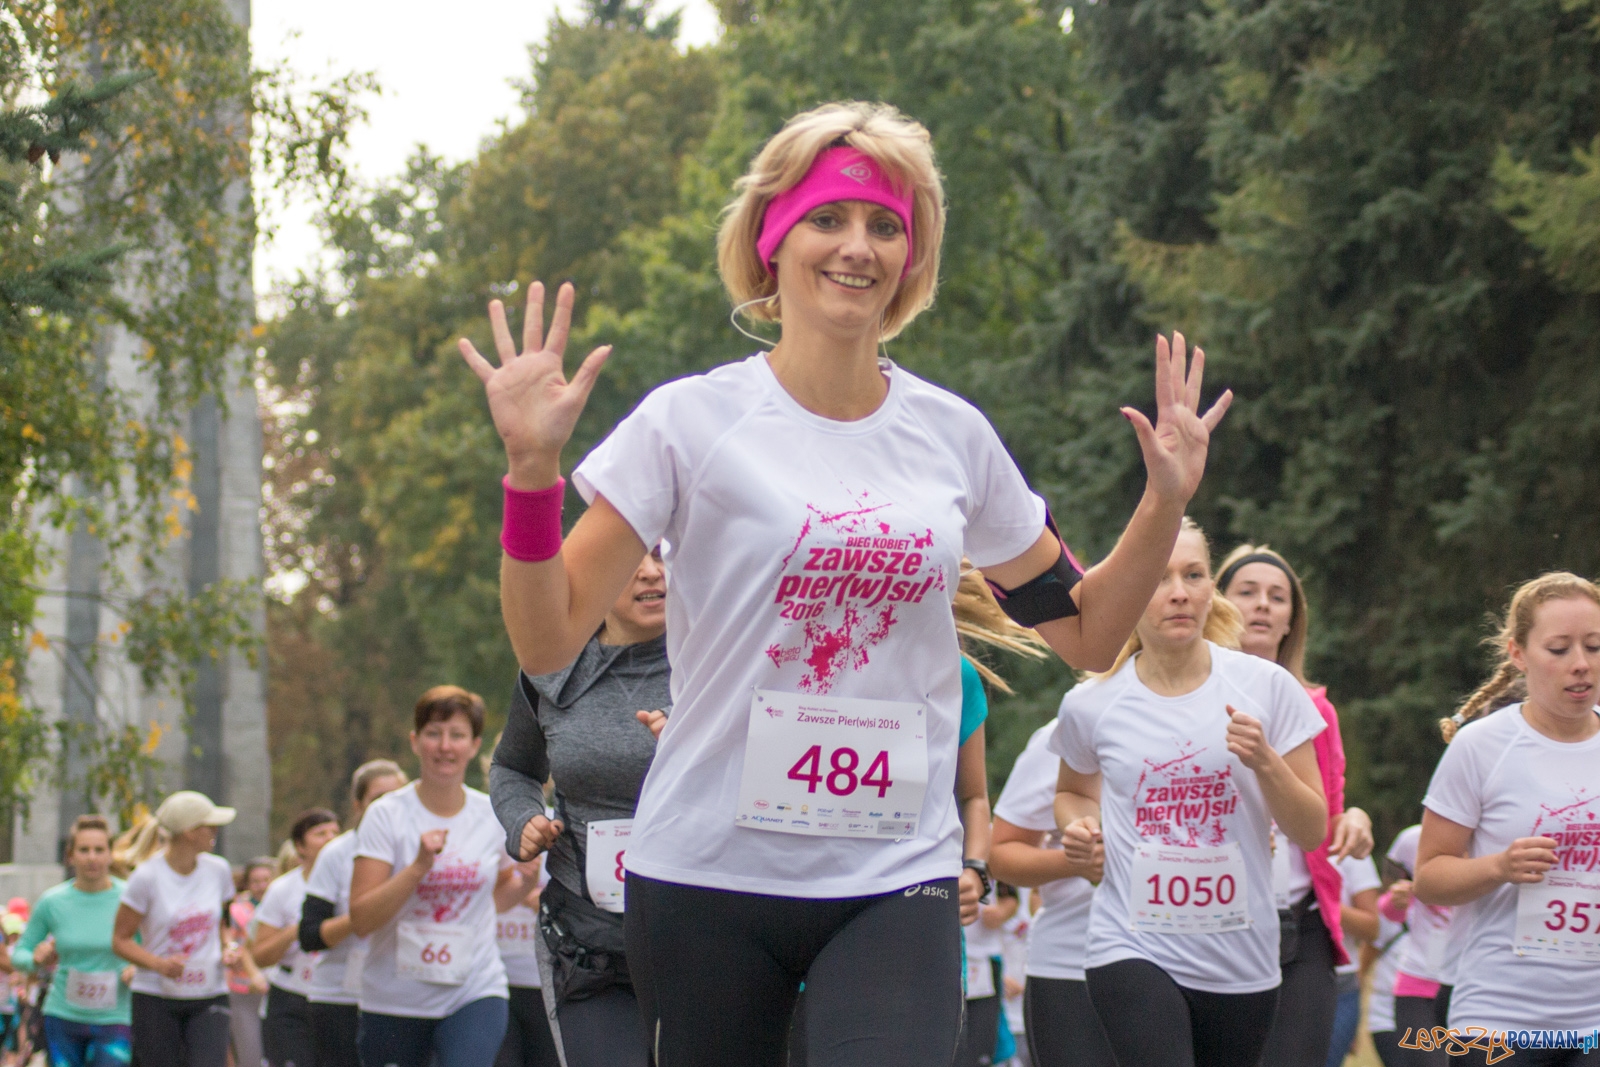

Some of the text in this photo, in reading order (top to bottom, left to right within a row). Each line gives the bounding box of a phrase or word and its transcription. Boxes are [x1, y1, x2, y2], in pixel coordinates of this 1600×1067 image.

[846, 536, 910, 550] BIEG KOBIET
[803, 548, 922, 576] zawsze
[774, 573, 934, 608] pier(w)si!
[780, 600, 826, 621] 2016
[797, 712, 835, 724] Zawsze
[838, 716, 876, 728] Pier(w)si
[878, 719, 900, 729] 2016
[787, 744, 893, 798] 484
[1146, 782, 1225, 803] zawsze
[1140, 823, 1171, 836] 2016
[922, 886, 949, 900] asics
[1147, 874, 1235, 907] 1050
[421, 942, 451, 964] 66
